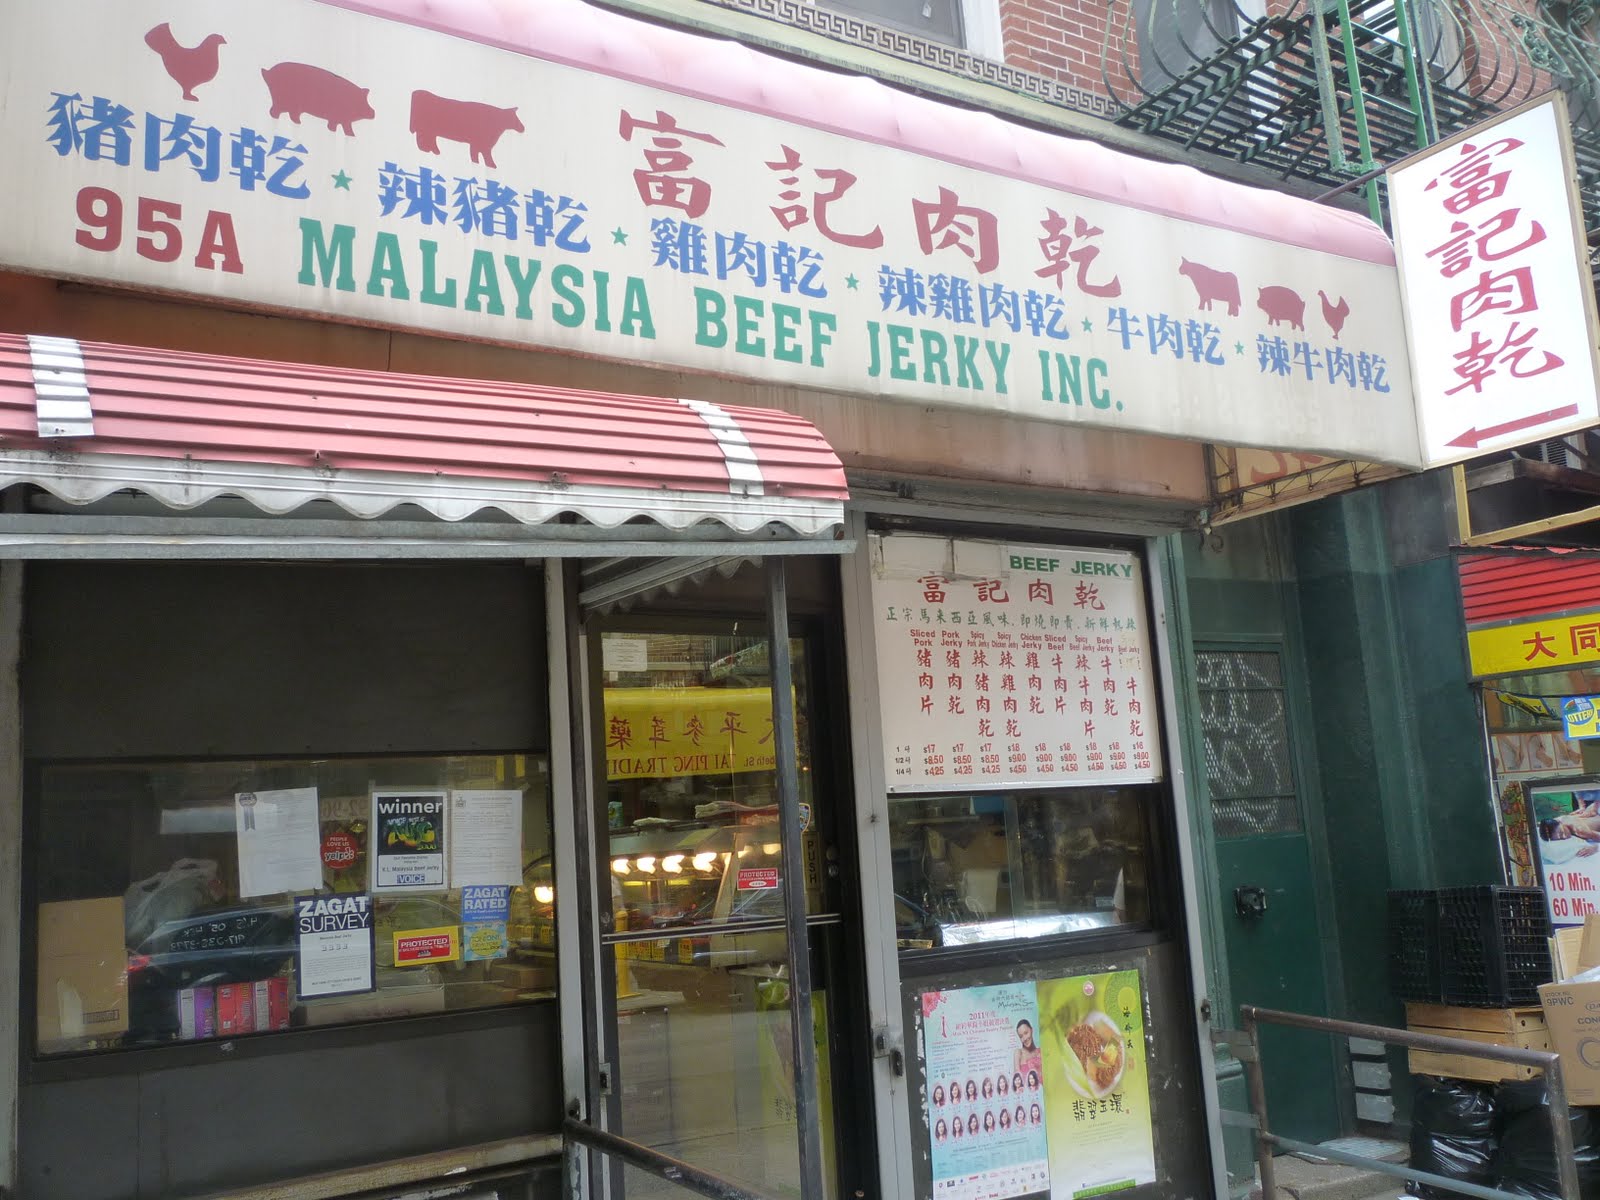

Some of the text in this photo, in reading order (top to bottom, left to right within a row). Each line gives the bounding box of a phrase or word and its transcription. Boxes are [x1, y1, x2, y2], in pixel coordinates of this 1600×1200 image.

[619, 109, 1121, 299] 富記肉乾
[46, 91, 1390, 393] 豬肉乾 辣豬乾 雞肉乾 辣雞肉乾 牛肉乾 辣牛肉乾
[1424, 137, 1565, 396] 富記肉乾
[75, 186, 1123, 412] 95A MALAYSIA BEEF JERKY INC.
[1010, 555, 1133, 577] BEEF JERKY
[917, 574, 1105, 611] 富記肉乾
[910, 629, 936, 638] Sliced
[941, 630, 960, 638] Pork
[970, 631, 985, 640] Spicy
[997, 632, 1011, 641] Spicy
[1020, 633, 1042, 641] Chicken
[1044, 634, 1067, 642] Sliced
[914, 638, 933, 646] Pork
[940, 639, 963, 648] Jerky
[1021, 641, 1042, 650] Jerky
[1047, 643, 1065, 651] Beef
[1523, 622, 1600, 661] 大同
[1096, 644, 1114, 653] Jerky
[1051, 653, 1067, 716] 牛肉片
[1101, 654, 1118, 716] 牛肉乾
[923, 744, 936, 753] $17
[952, 743, 964, 753] $17
[980, 743, 992, 752] $17
[379, 798, 442, 814] winner
[324, 850, 345, 861] yelp
[808, 841, 817, 883] PUSH
[397, 874, 425, 884] VOICE
[1550, 872, 1595, 891] 10 Min.
[464, 888, 507, 898] ZAGAT
[299, 896, 369, 917] ZAGAT
[464, 898, 507, 909] RATED
[1553, 898, 1568, 916] 60
[300, 912, 369, 933] SURVEY
[401, 938, 448, 948] PROTECTED
